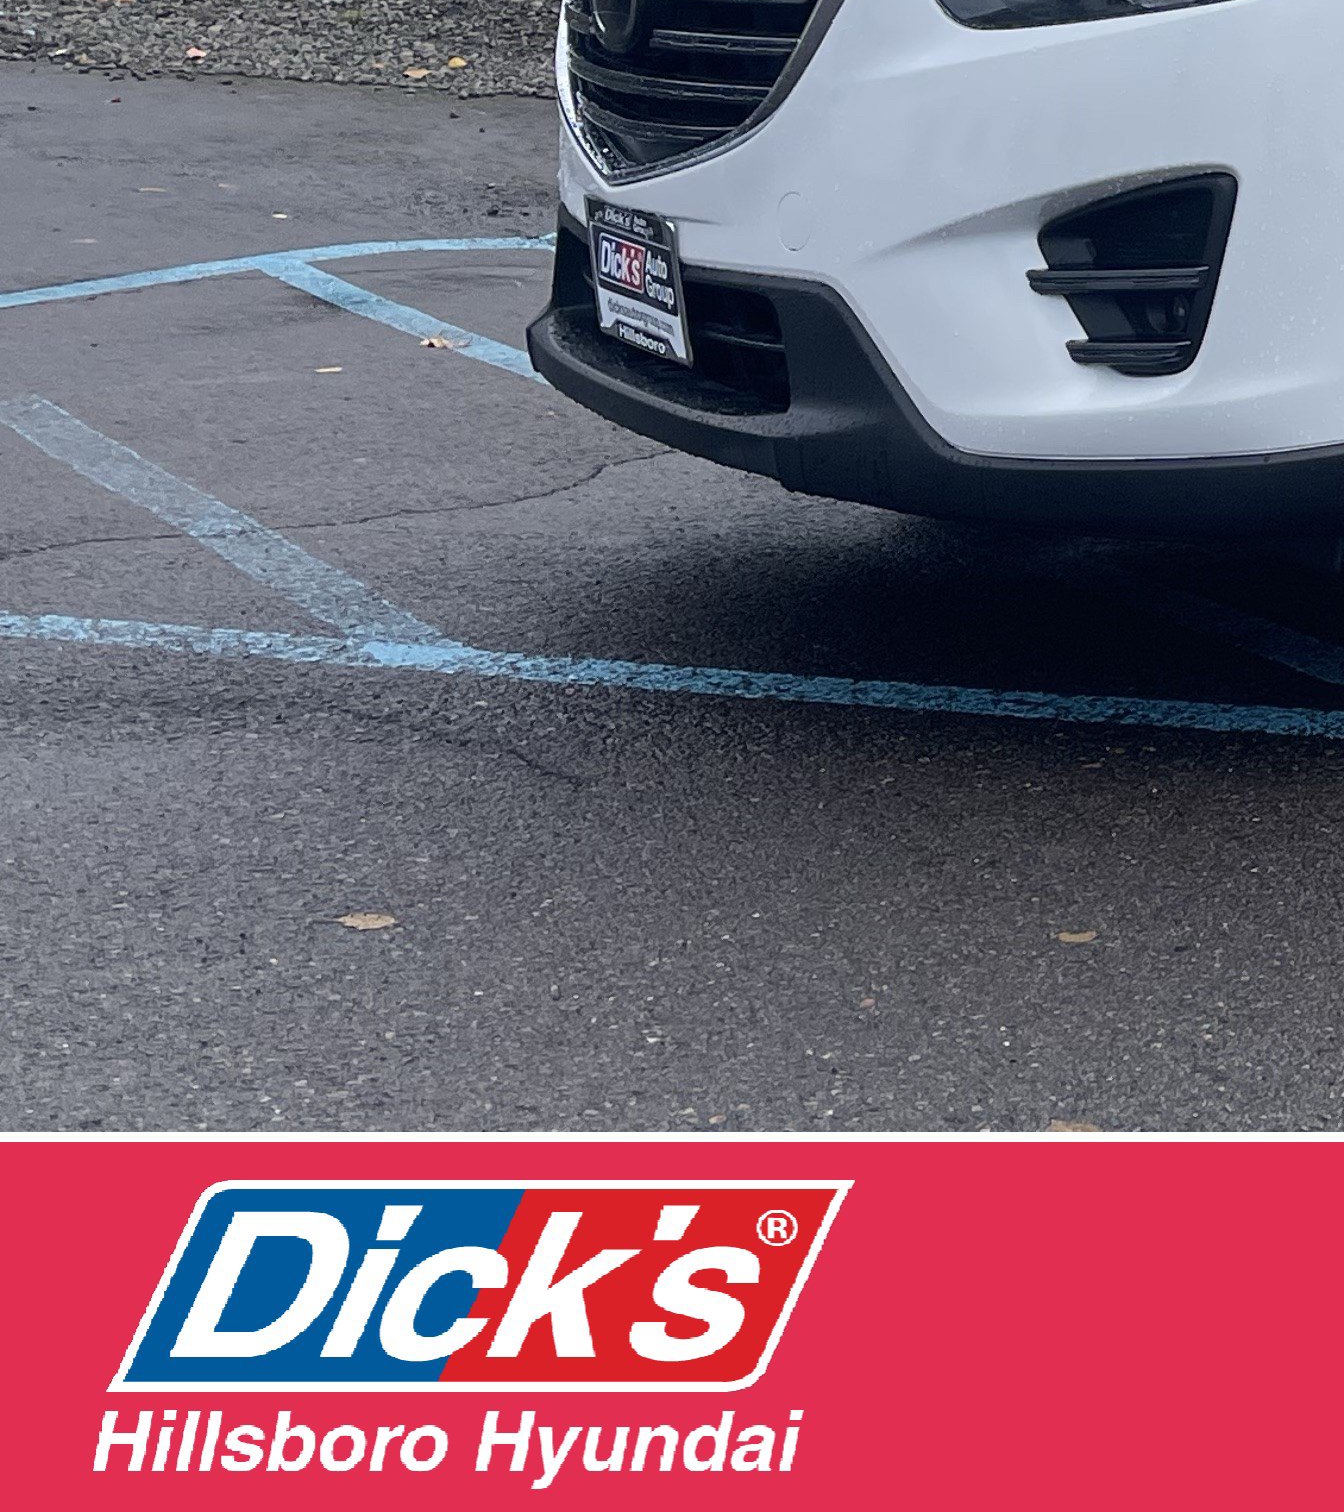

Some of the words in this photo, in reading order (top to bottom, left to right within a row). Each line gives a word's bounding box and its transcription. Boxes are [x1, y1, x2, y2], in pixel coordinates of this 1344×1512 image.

[601, 239, 641, 287] Dick's
[645, 249, 668, 280] Auto
[645, 274, 675, 310] Group
[618, 323, 666, 355] Hillsboro
